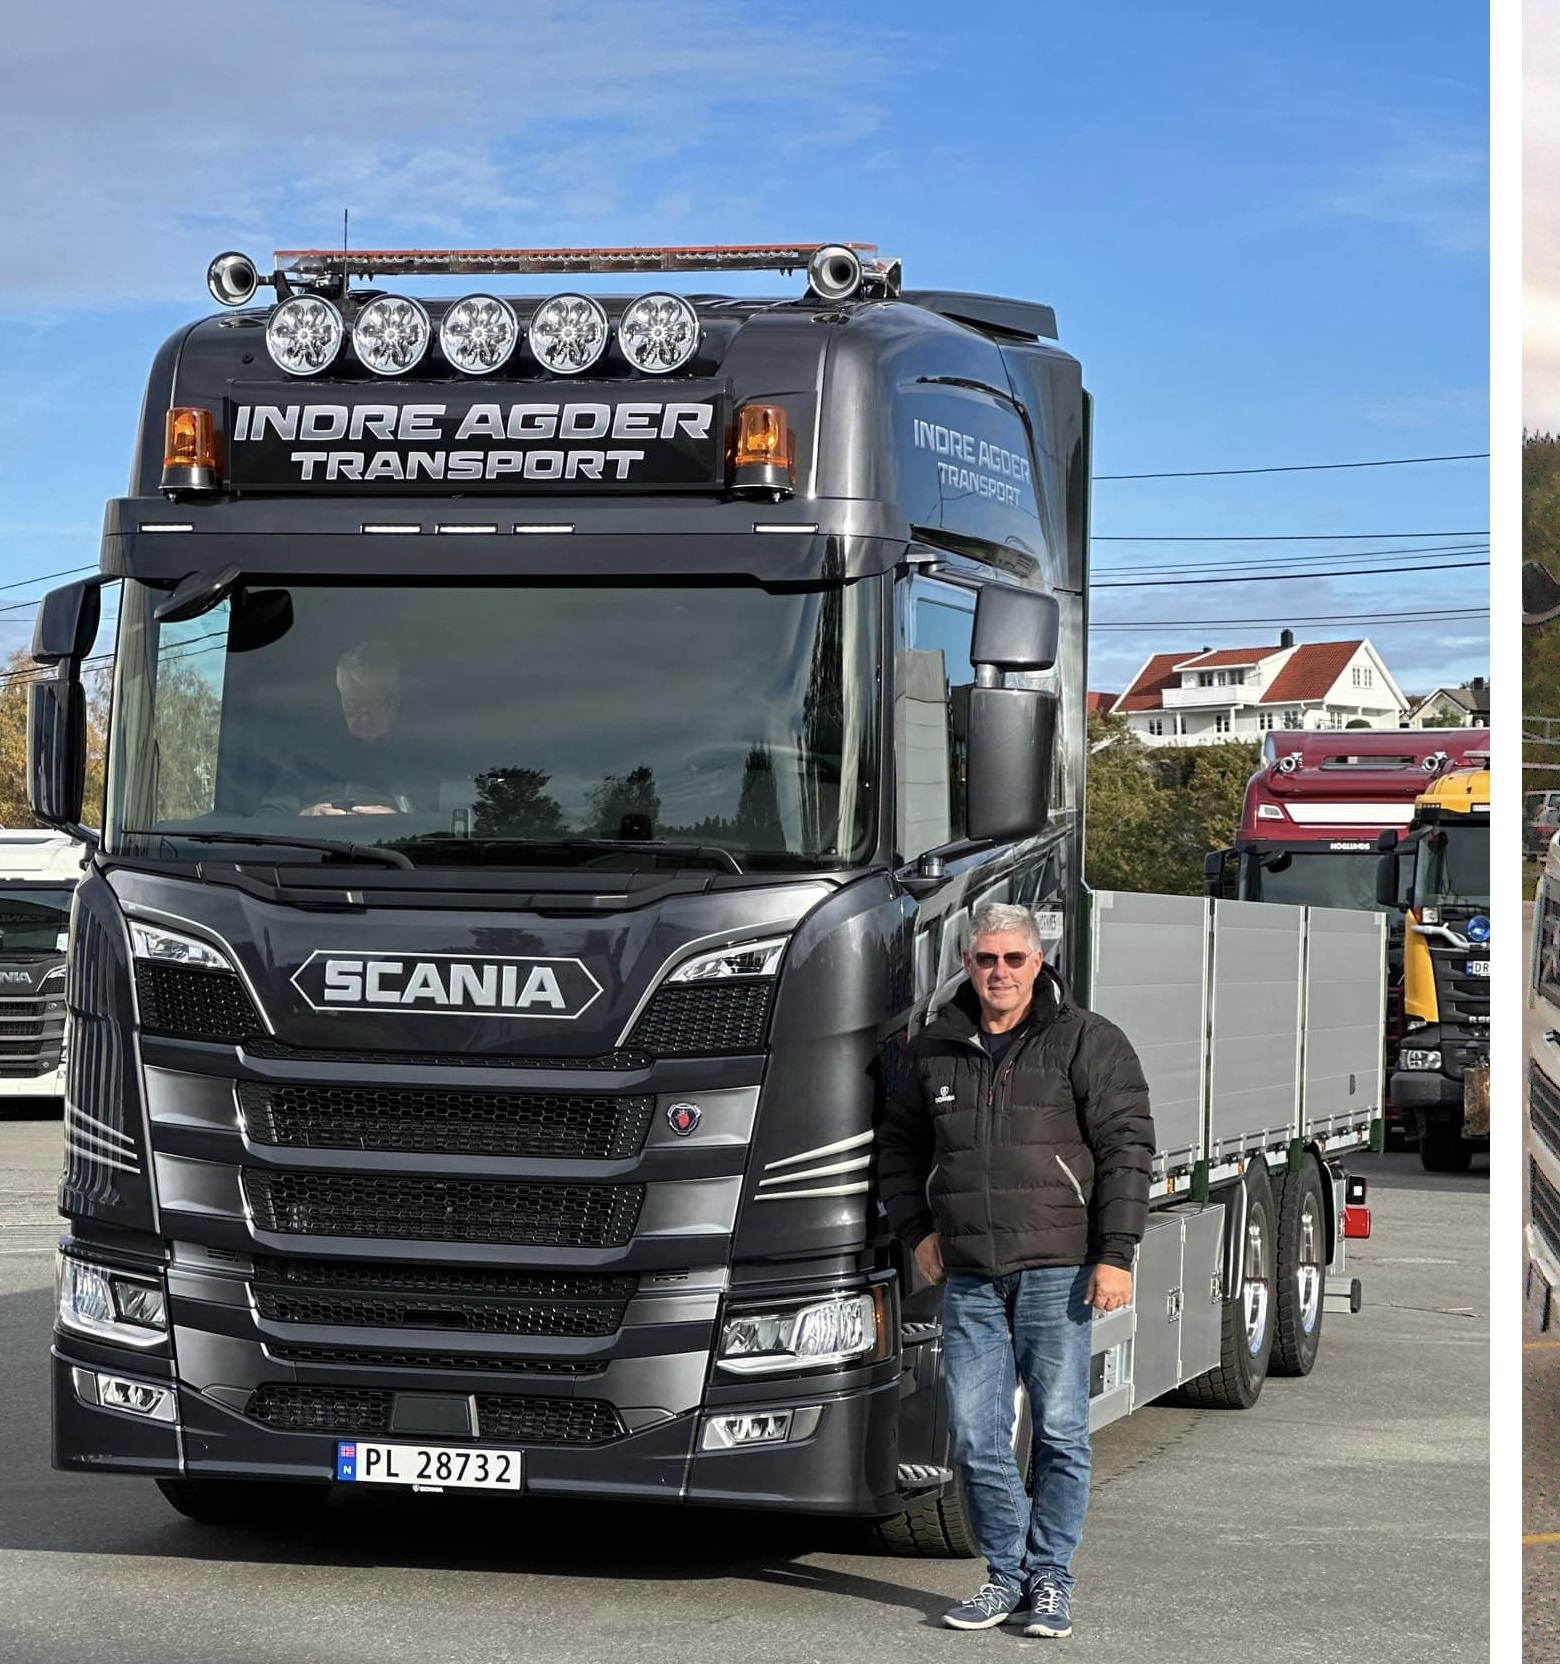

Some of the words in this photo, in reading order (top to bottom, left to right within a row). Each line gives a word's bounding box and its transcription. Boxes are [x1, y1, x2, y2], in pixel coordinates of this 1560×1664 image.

[234, 404, 447, 441] INDRE
[454, 403, 714, 440] AGDER
[290, 450, 645, 481] TRANSPORT
[914, 419, 976, 463] INDRE
[978, 440, 1030, 484] AGDER
[937, 461, 1021, 507] TRANSPORT
[324, 959, 566, 1008] SCANIA
[343, 1465, 352, 1475] N
[365, 1448, 399, 1477] PL
[416, 1450, 511, 1483] 28732
